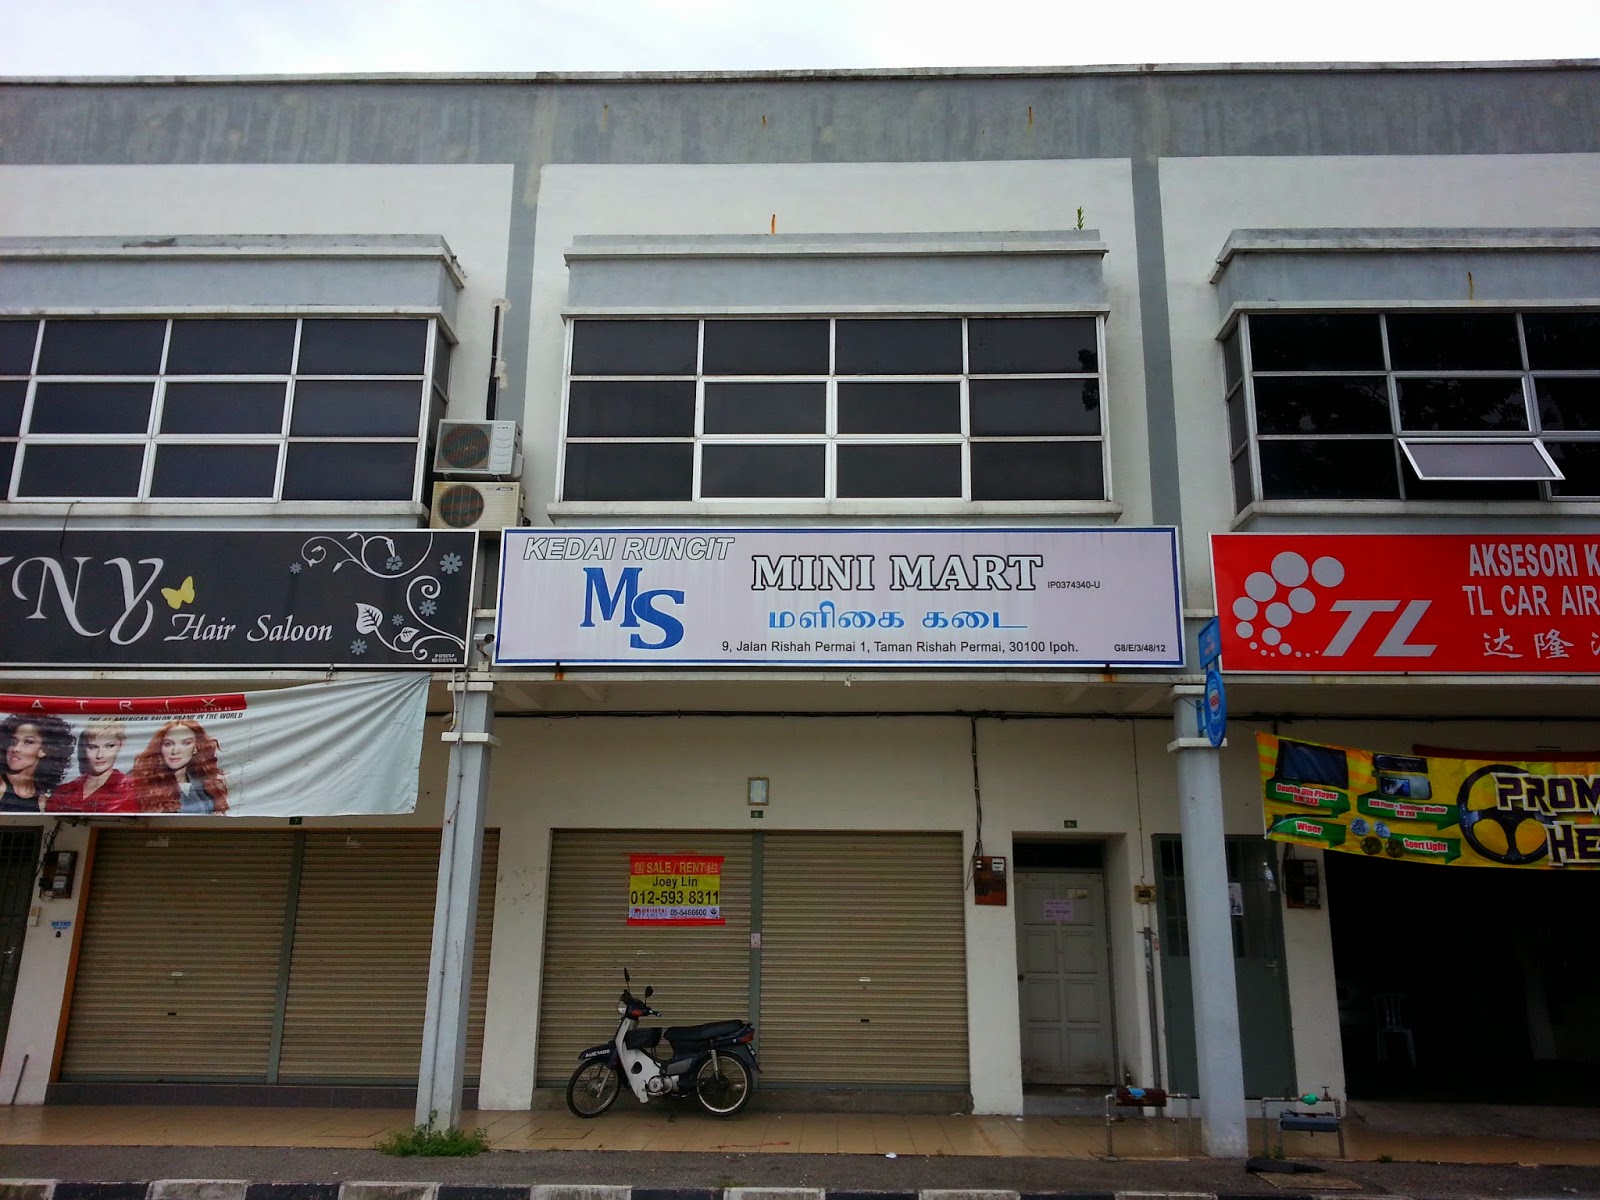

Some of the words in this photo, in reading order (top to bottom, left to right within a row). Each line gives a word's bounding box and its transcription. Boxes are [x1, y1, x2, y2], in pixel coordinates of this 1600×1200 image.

[523, 537, 615, 561] KEDAI
[622, 537, 735, 561] RUNCIT
[1469, 543, 1579, 577] AKSESORI
[751, 555, 876, 591] MINI
[889, 555, 1044, 591] MART
[1047, 580, 1101, 589] IP0374340-U
[0, 556, 163, 645] NY
[580, 567, 686, 650] MS
[1462, 585, 1493, 616] TL
[1501, 584, 1551, 616] CAR
[1561, 585, 1600, 616] AIR
[164, 613, 236, 641] Hair
[247, 614, 333, 642] Saloon
[768, 600, 905, 629] மளிகை
[922, 610, 1029, 629] கடை
[1322, 600, 1438, 657] TL
[722, 641, 732, 653] 9,
[736, 641, 767, 652] Jalan
[771, 641, 811, 652] Rishah
[815, 641, 856, 652] Permai
[860, 641, 870, 654] 1,
[874, 641, 913, 652] Taman
[917, 641, 957, 652] Rishah
[961, 641, 1005, 654] Permai,
[1009, 641, 1046, 652] 30100
[1049, 641, 1079, 655] Ipoh.
[1113, 643, 1167, 653] G8/E/3/48/12
[1483, 628, 1600, 659] 达隆
[1296, 821, 1323, 835] Wiper
[1403, 838, 1424, 850] Sport
[1424, 840, 1448, 852] Light
[646, 862, 671, 873] SALE
[680, 862, 706, 873] RENT
[652, 876, 678, 889] Joey
[681, 876, 698, 887] Lin
[630, 890, 684, 905] 012-593
[688, 890, 719, 905] 8311
